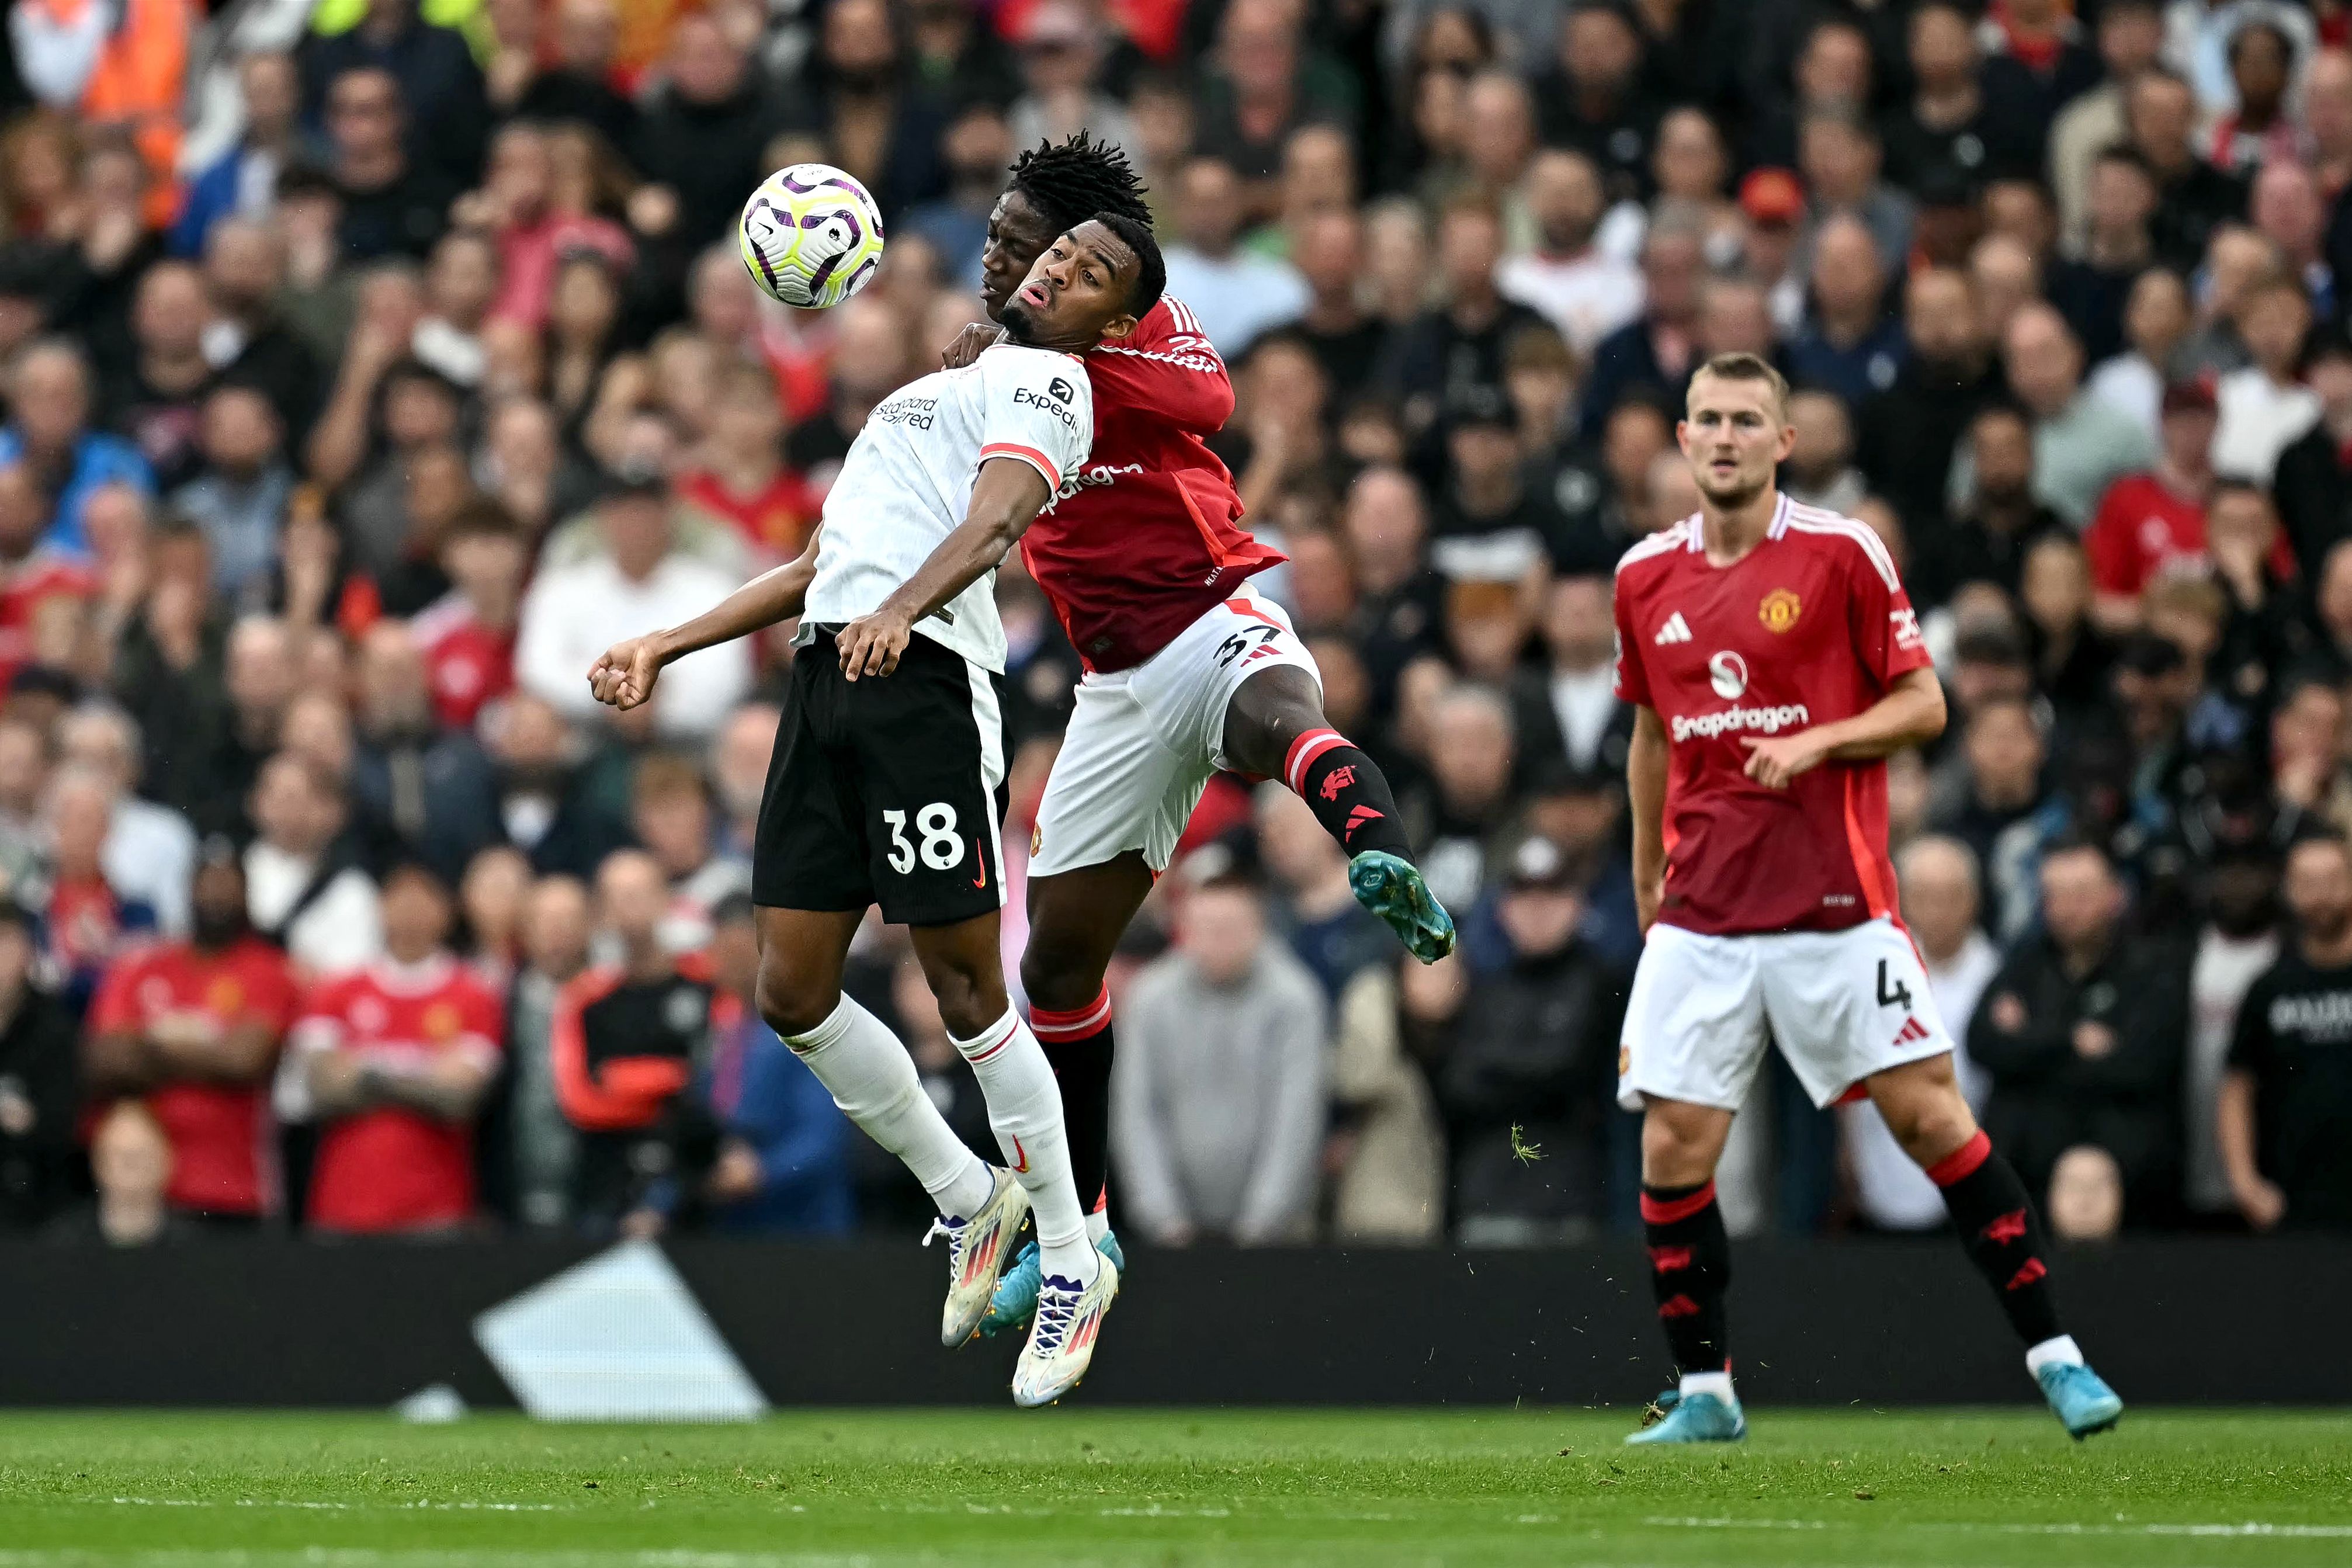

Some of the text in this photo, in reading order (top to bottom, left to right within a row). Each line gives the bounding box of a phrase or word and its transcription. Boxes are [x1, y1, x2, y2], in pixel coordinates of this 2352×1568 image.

[1014, 388, 1078, 436] Expedi
[1213, 625, 1281, 668] 37
[1672, 703, 1808, 743] Snapdragon
[883, 802, 965, 875] 38
[1877, 958, 1912, 1011] 4
